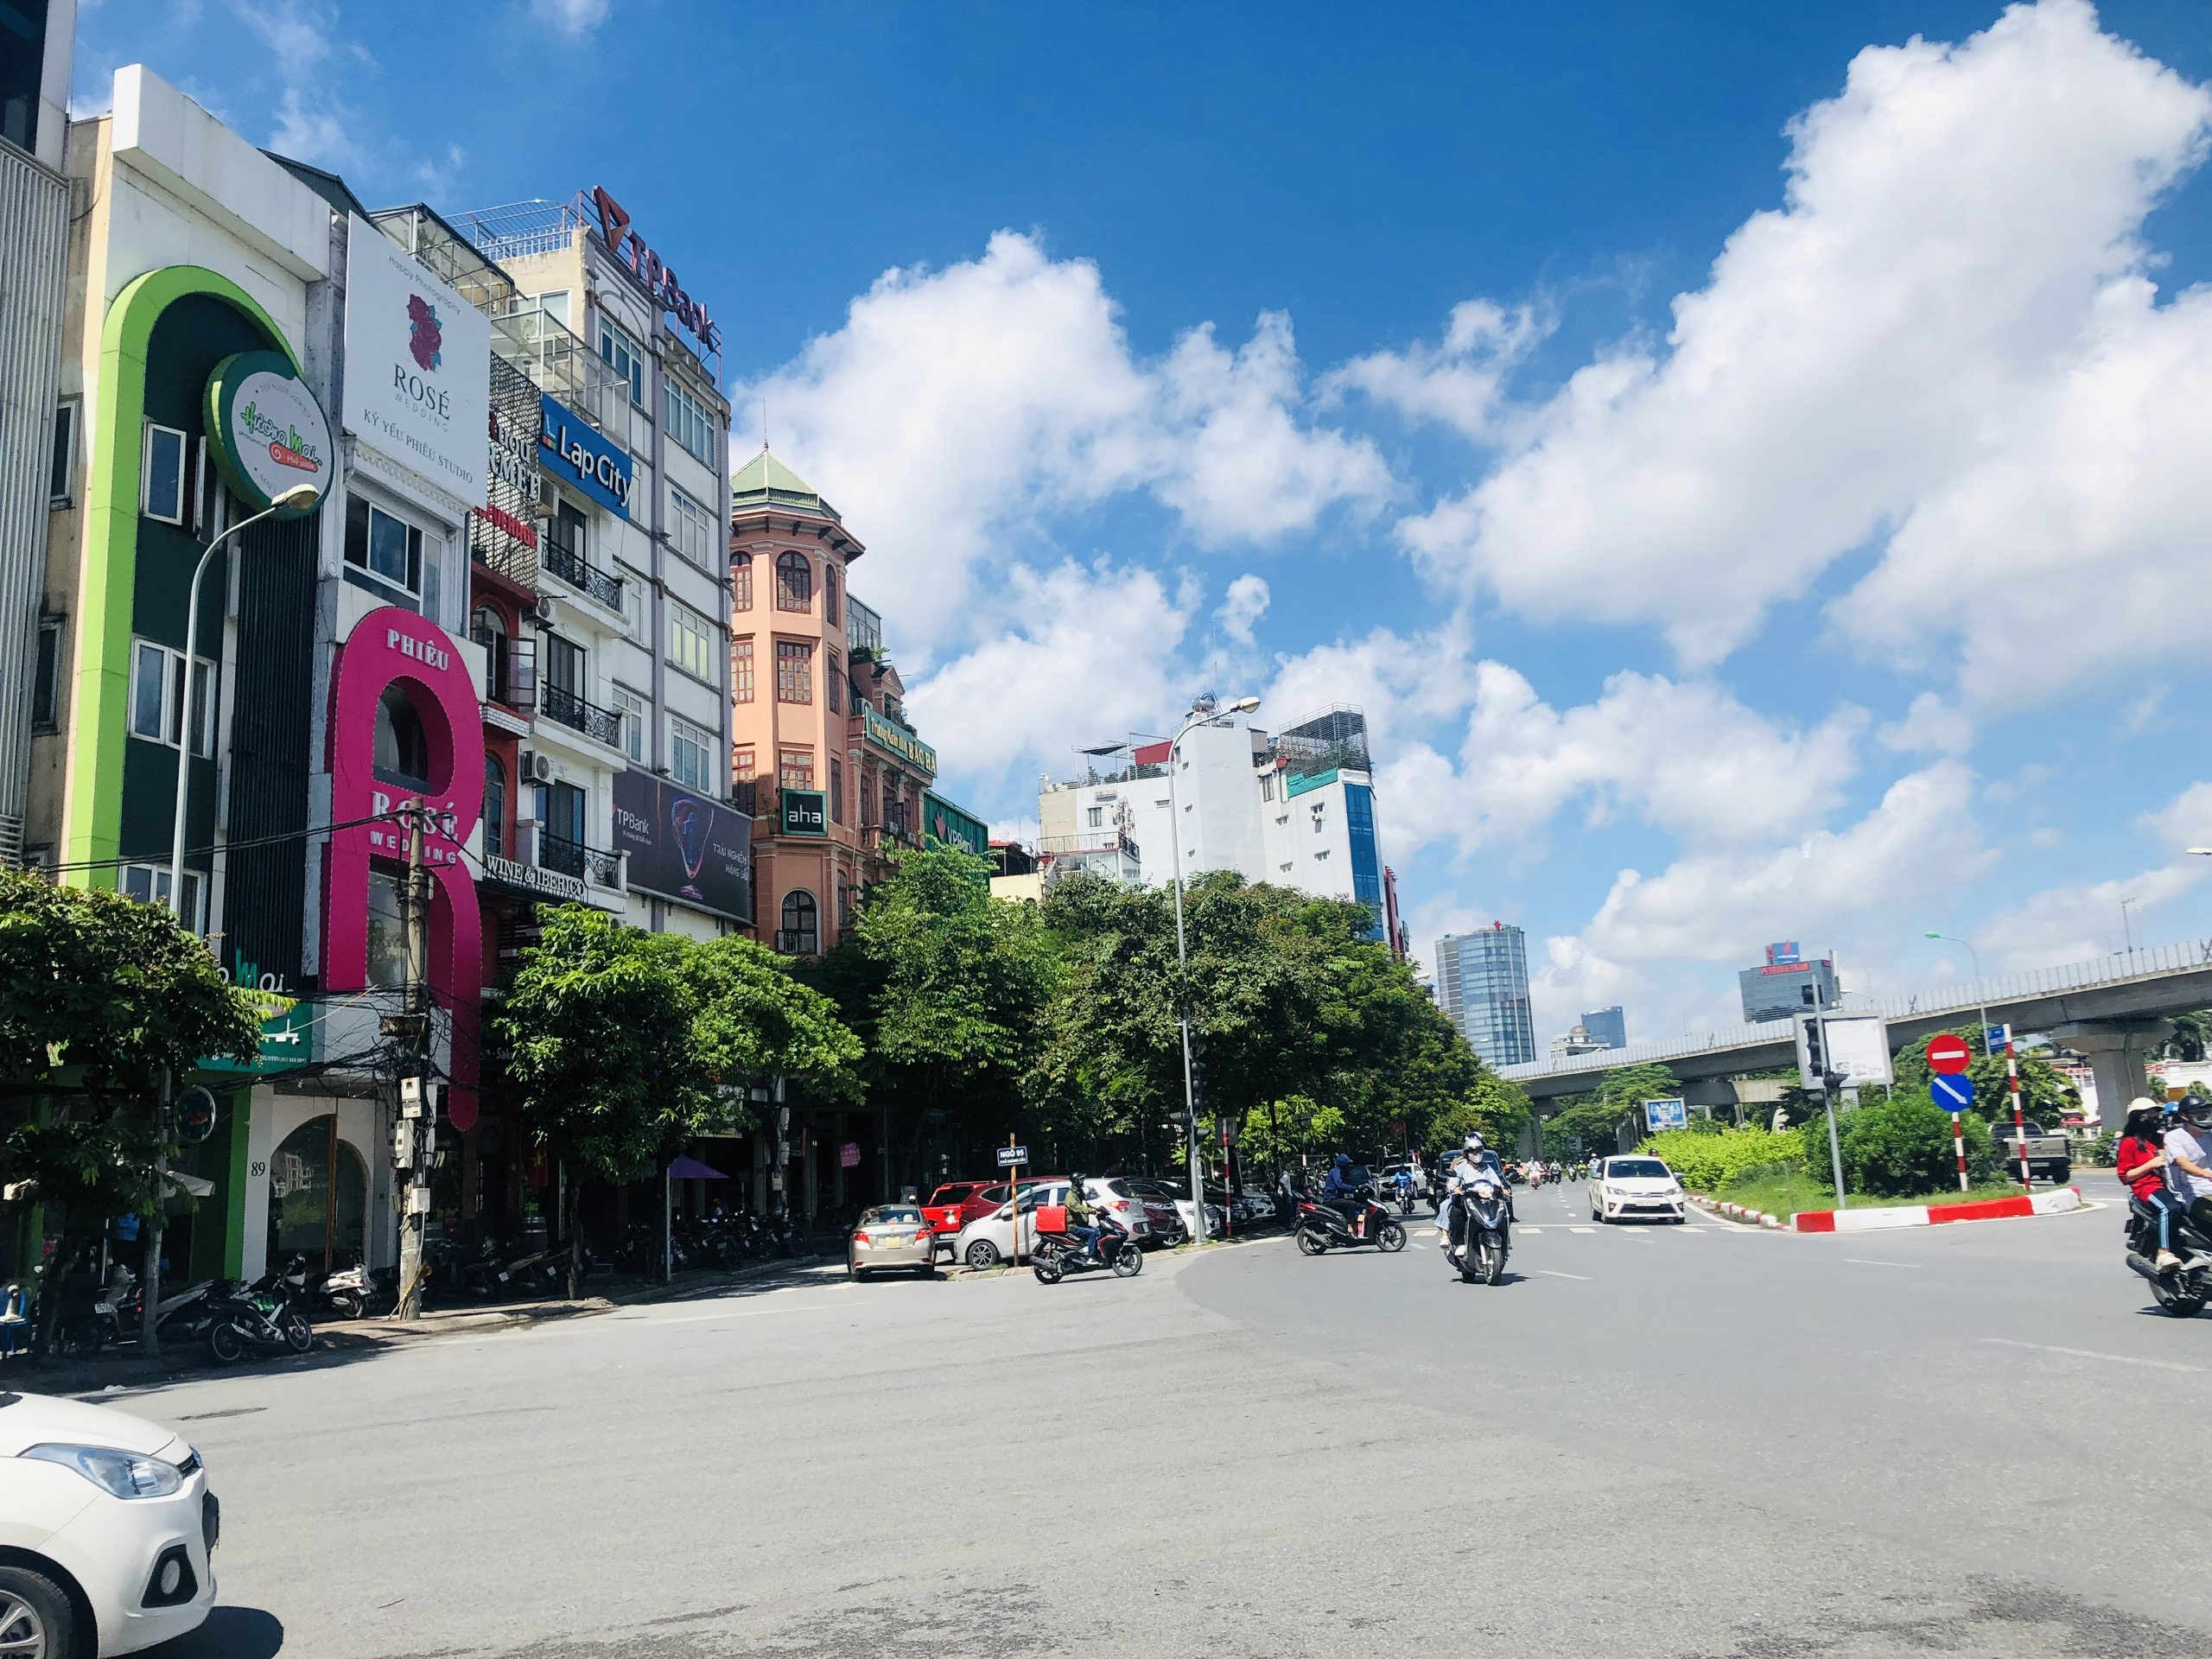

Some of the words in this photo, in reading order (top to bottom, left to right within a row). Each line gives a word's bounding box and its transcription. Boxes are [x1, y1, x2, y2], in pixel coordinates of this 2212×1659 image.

[389, 254, 413, 280] Happy
[416, 274, 461, 316] Photography
[628, 229, 715, 353] TPBank
[393, 363, 449, 421] ROSÉ
[395, 391, 448, 433] WEDDING
[438, 454, 473, 484] STUDIO
[386, 628, 449, 671] PHIÊU
[925, 751, 936, 774] HÀ
[617, 808, 649, 835] TPBank
[789, 804, 822, 823] aha
[370, 831, 456, 864] WEDING
[486, 855, 523, 882] WINE
[536, 868, 586, 897] IBERICO
[251, 1161, 265, 1176] 89
[1000, 1148, 1015, 1158] NGÕ
